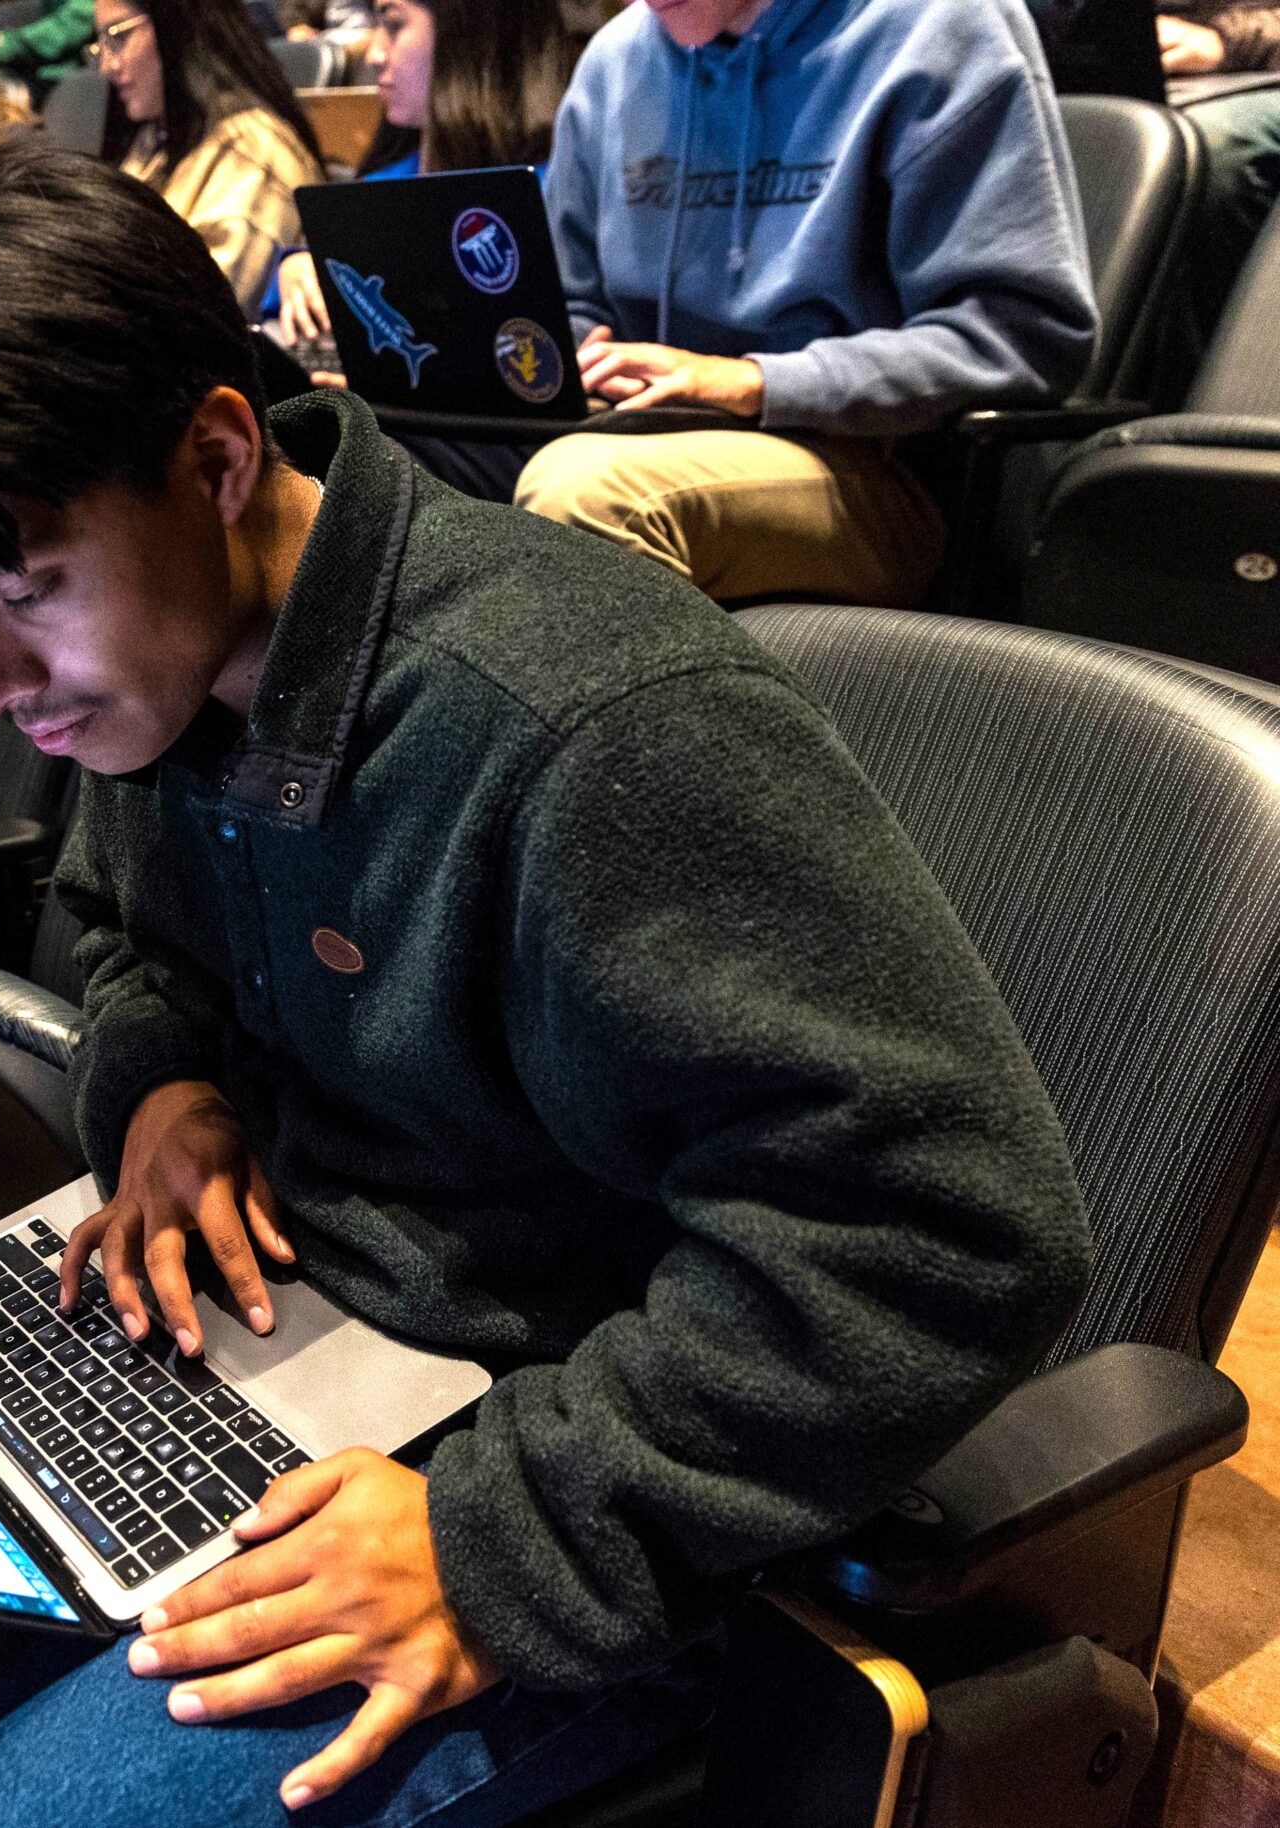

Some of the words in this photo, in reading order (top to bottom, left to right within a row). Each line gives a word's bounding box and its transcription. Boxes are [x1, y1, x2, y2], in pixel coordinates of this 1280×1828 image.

[87, 1323, 97, 1331] M
[48, 1331, 58, 1339] K
[83, 1366, 94, 1374] H
[164, 1394, 173, 1402] C
[219, 1387, 241, 1406] command
[184, 1414, 195, 1422] X
[247, 1411, 263, 1425] option
[95, 1427, 105, 1435] R
[141, 1423, 152, 1432] D
[205, 1434, 216, 1442] Z
[269, 1432, 288, 1447] control
[113, 1448, 124, 1456] E
[96, 1475, 106, 1483] 3
[156, 1489, 166, 1499] Q
[223, 1489, 234, 1501] lock
[116, 1496, 127, 1505] 2
[232, 1498, 245, 1510] caps
